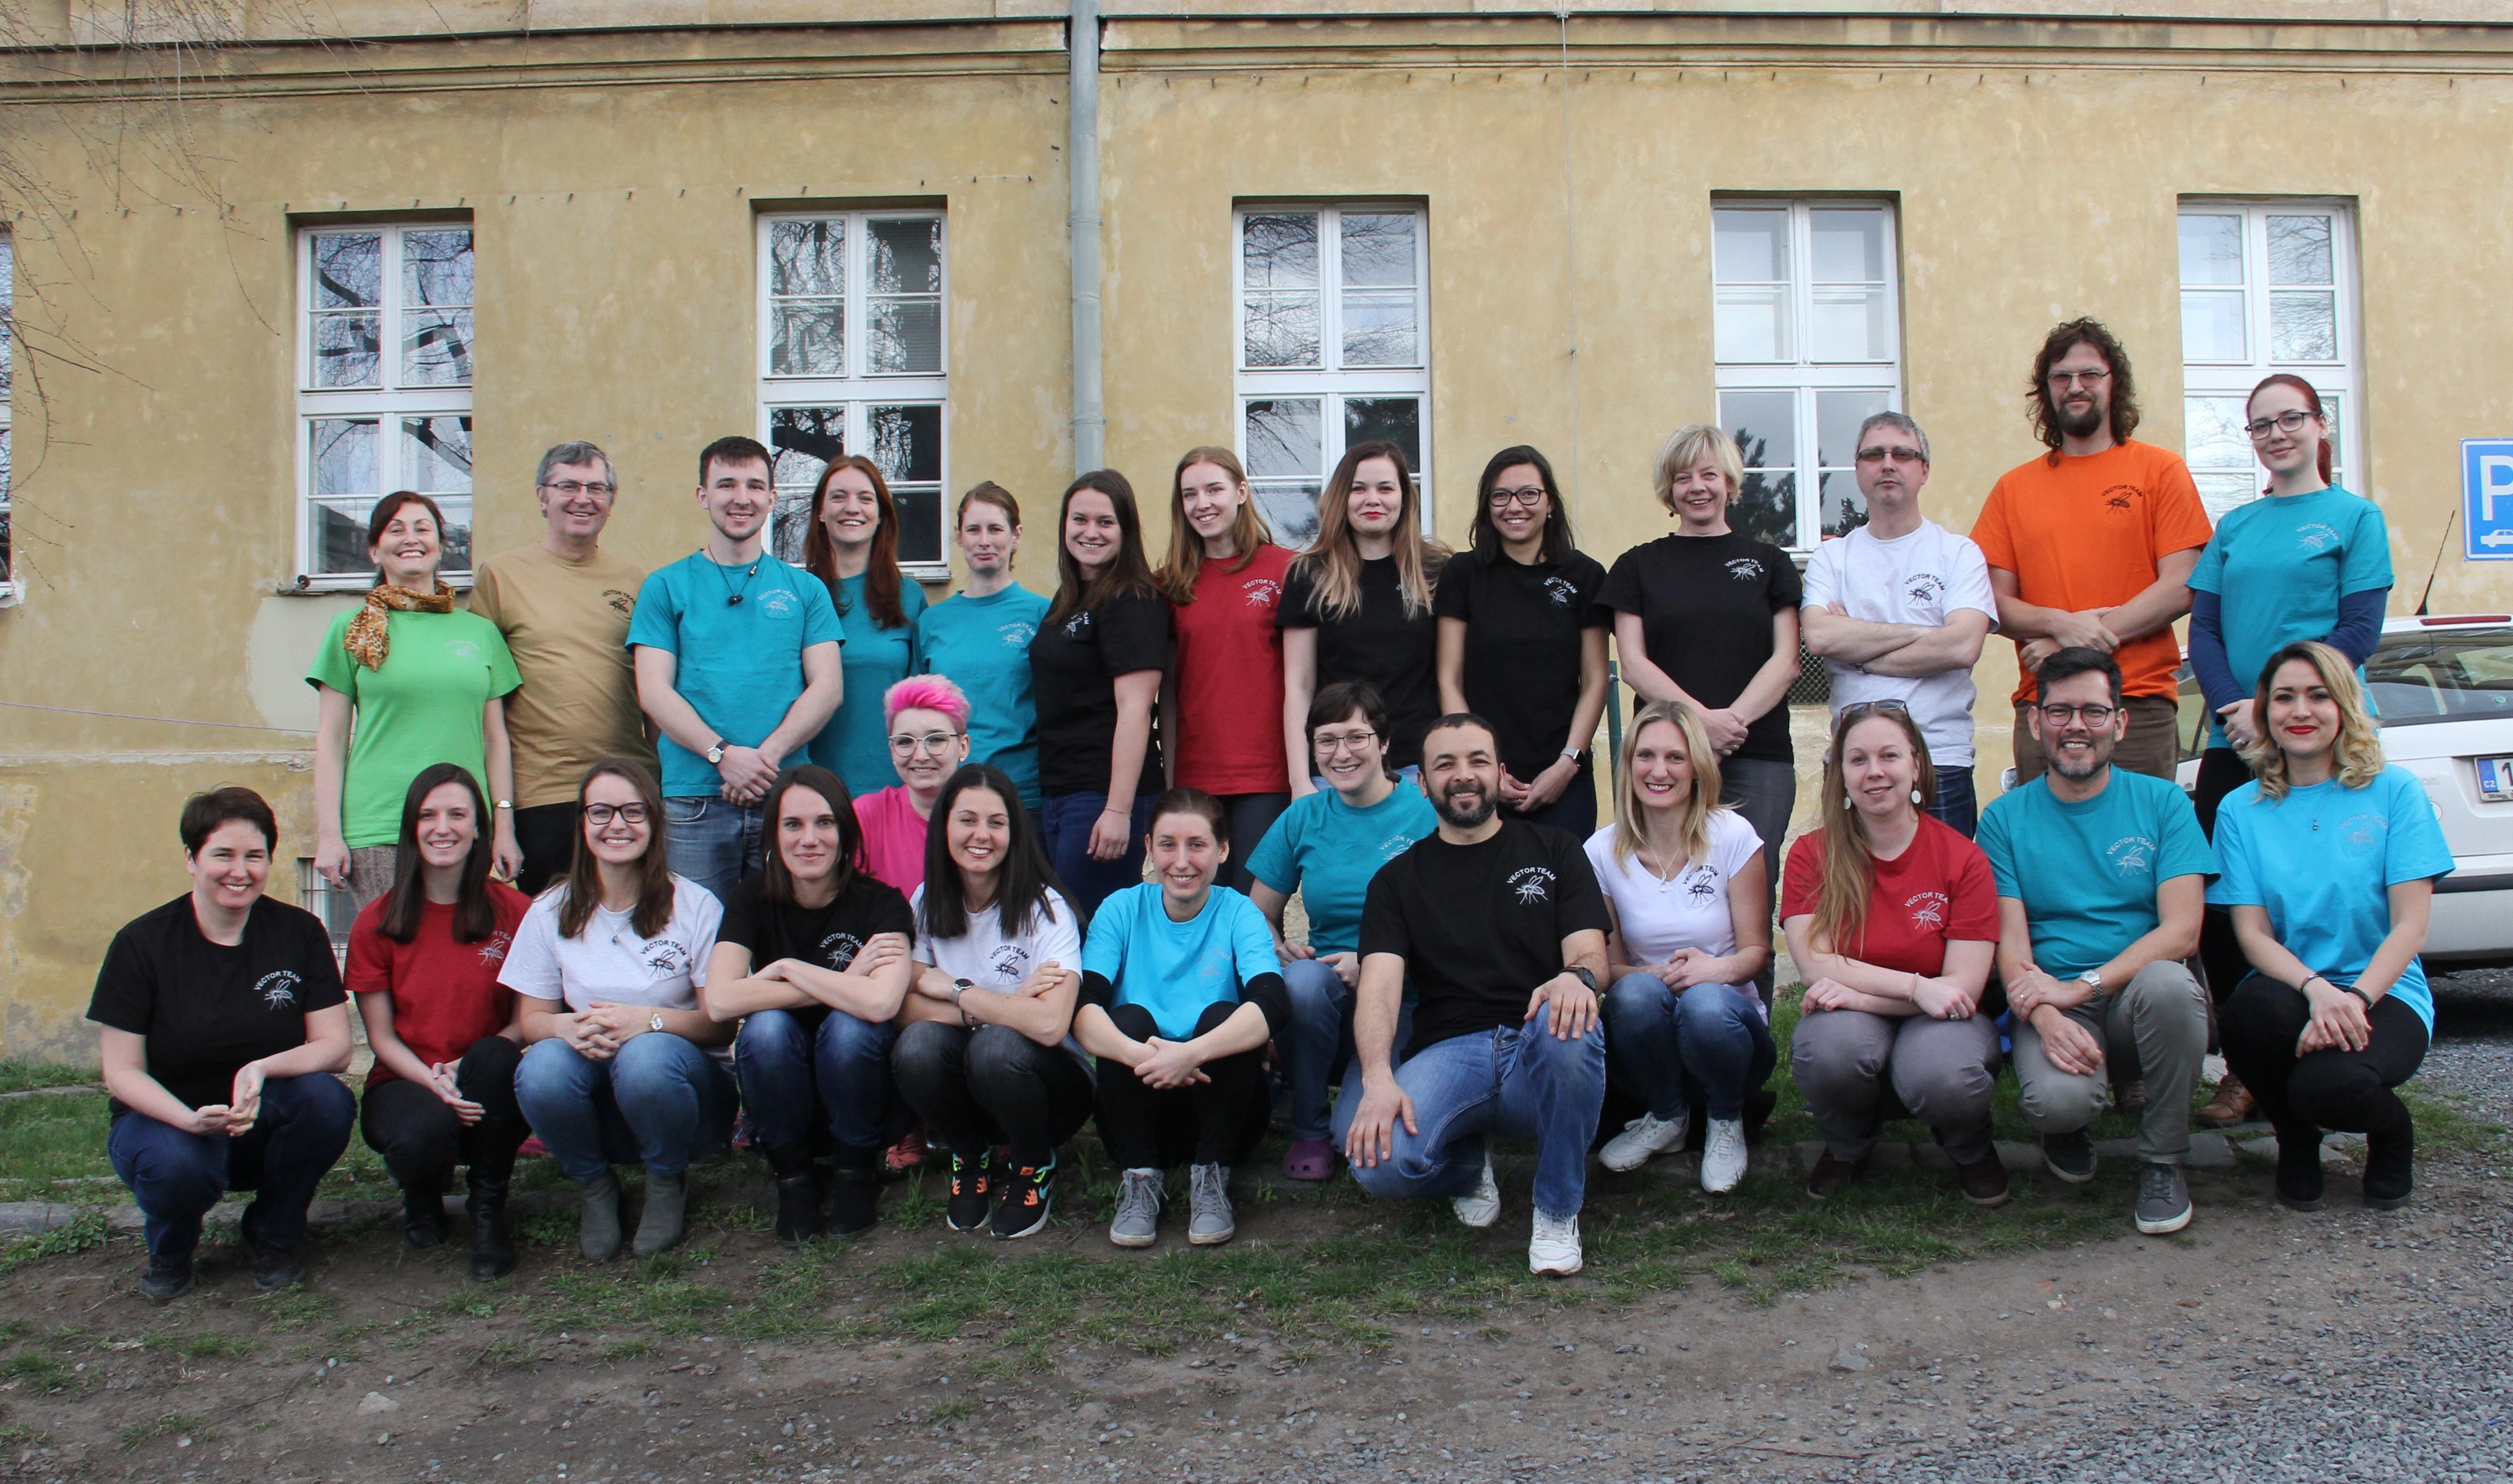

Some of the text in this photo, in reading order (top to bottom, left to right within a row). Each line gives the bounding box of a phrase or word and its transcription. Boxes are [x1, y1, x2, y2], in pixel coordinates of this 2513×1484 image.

[2102, 484, 2143, 497] VECTOR TEAM
[2480, 455, 2513, 520] P
[2296, 523, 2340, 540] VECTOR TEAM
[1724, 558, 1764, 573] VECTOR TEAM
[1242, 579, 1282, 595] VECTOR TEAM
[1543, 576, 1578, 594] VECTOR TEAM
[1904, 573, 1945, 591] VECTOR TEAM
[758, 589, 797, 602] VECTOR TEAM
[997, 623, 1036, 636] VECTOR TEAM
[2483, 780, 2496, 788] CZ
[1379, 835, 1405, 850] VECTOR
[2107, 837, 2156, 855] VECTOR TEAM
[1506, 866, 1557, 884] VECTOR TEAM
[1904, 891, 1949, 908] VECTOR TEA
[640, 940, 687, 956] VECTOR TEAM
[820, 932, 864, 949] VECTOR TEAM
[989, 945, 1029, 960] VECTOR TEAM
[254, 970, 302, 991] VECTOR TEAM
